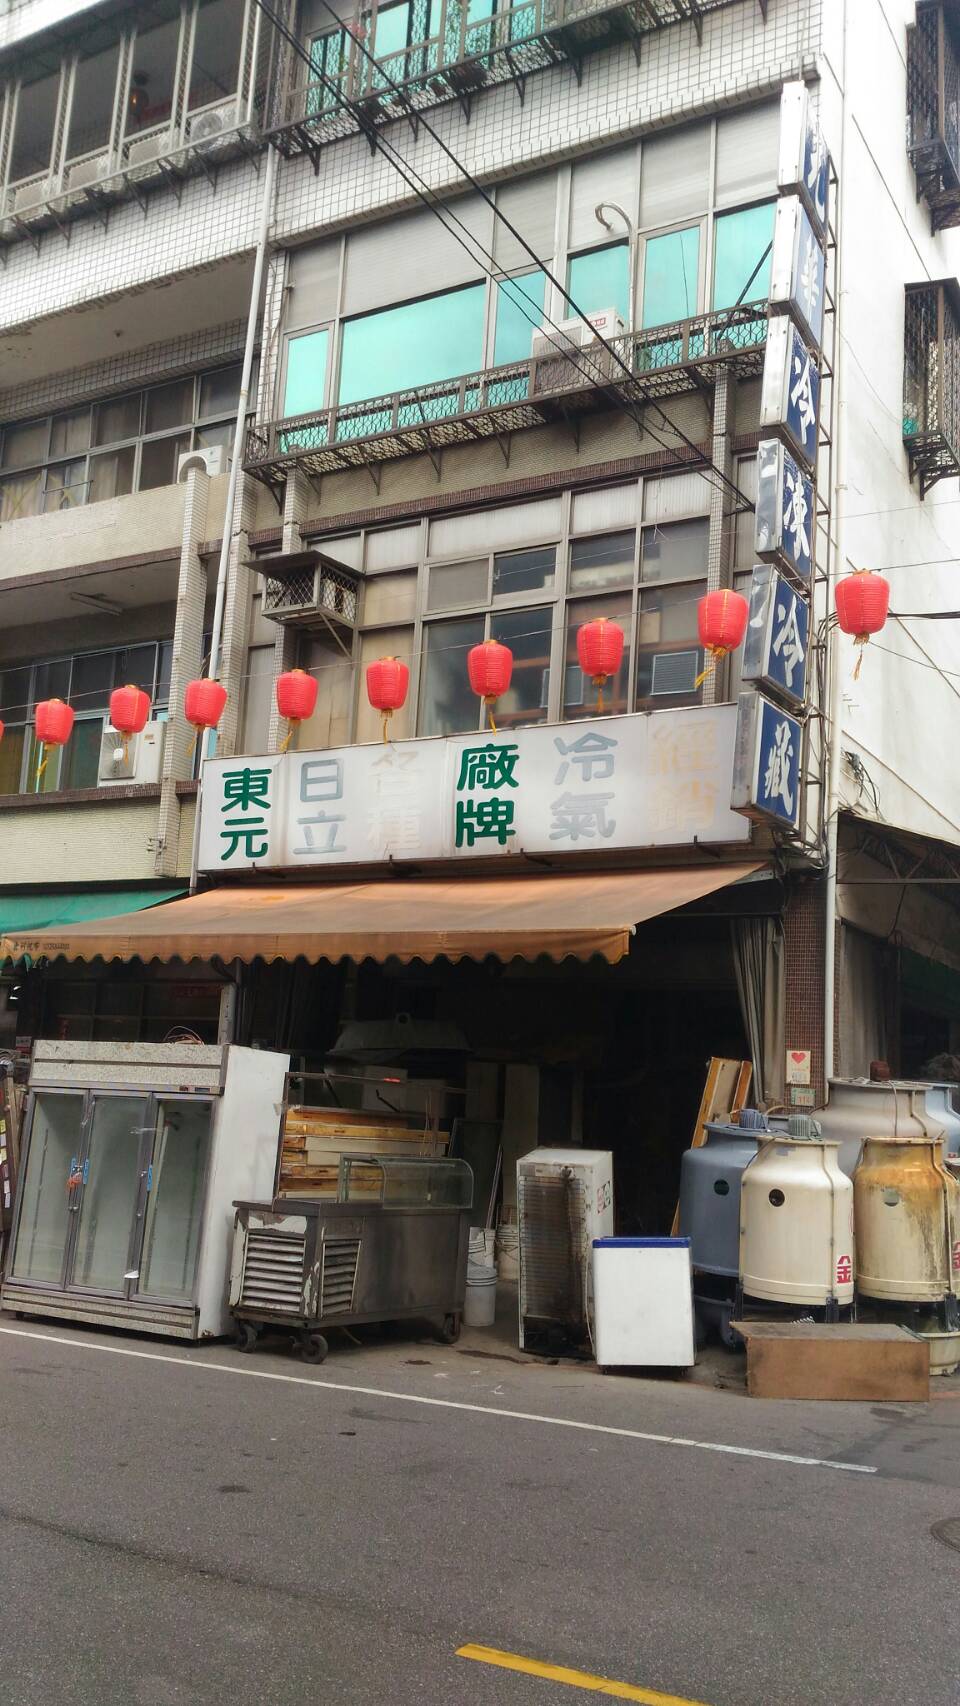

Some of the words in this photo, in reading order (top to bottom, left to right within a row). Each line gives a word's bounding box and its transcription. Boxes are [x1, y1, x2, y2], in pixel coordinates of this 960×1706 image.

[220, 767, 272, 861] 東元
[293, 758, 347, 855] 日立
[455, 743, 520, 848] 廠牌
[548, 732, 618, 841] 冷氣
[836, 1255, 851, 1284] 金
